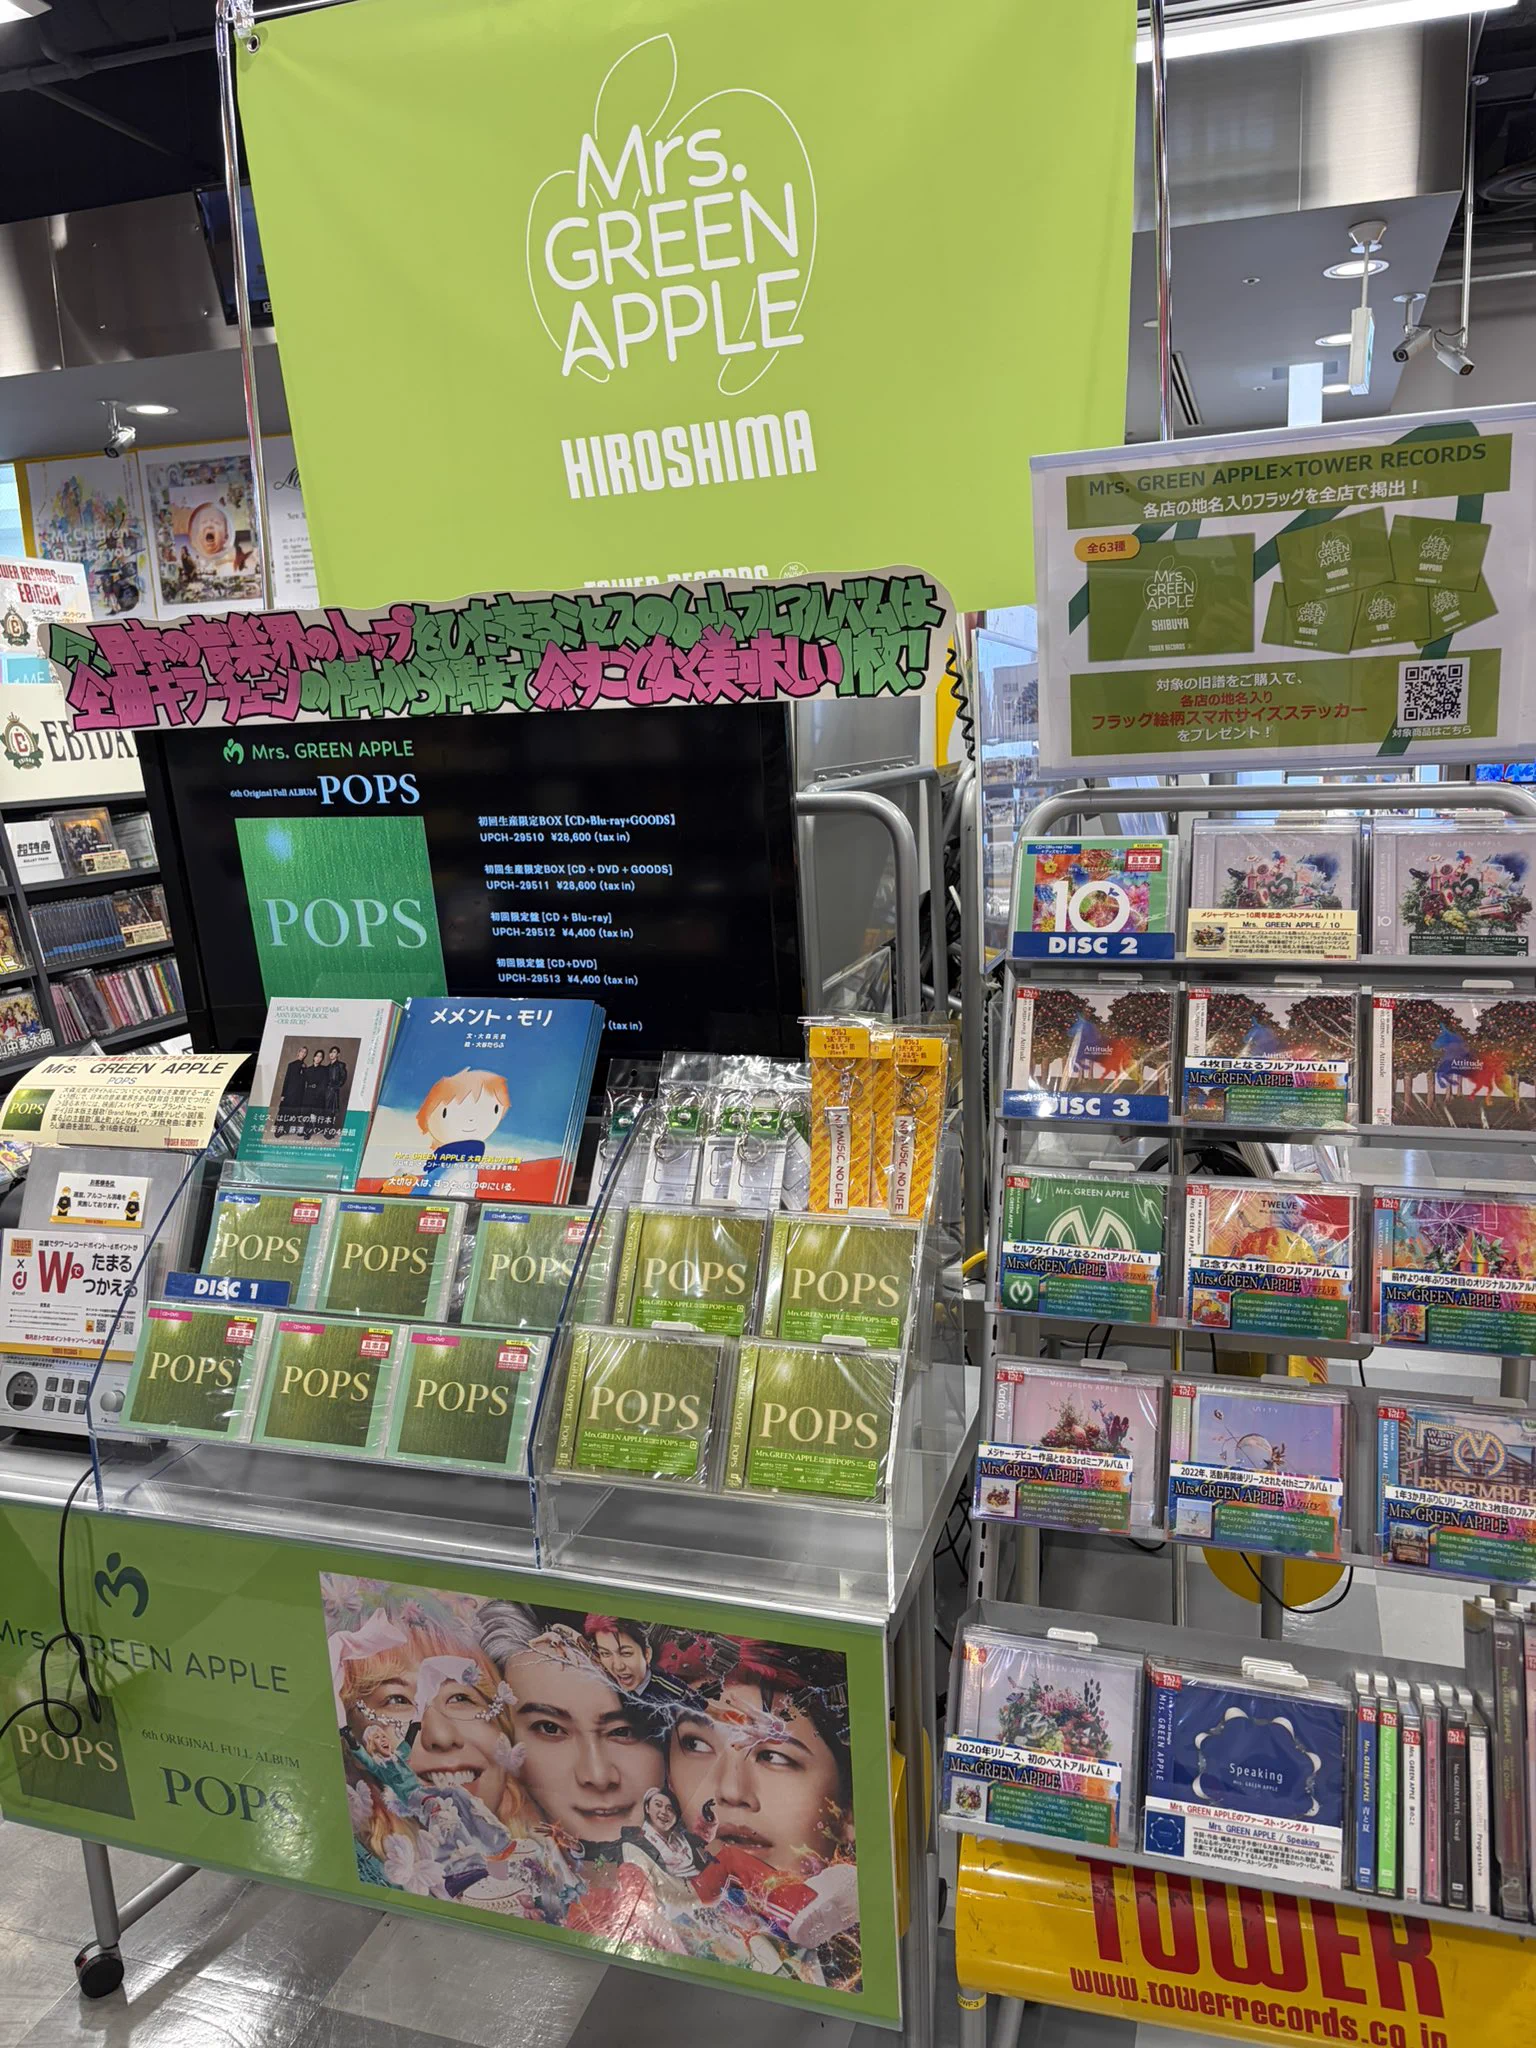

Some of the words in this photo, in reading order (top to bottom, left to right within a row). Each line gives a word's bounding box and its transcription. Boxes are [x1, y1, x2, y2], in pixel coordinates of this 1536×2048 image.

[577, 124, 748, 208] Mrs.
[545, 182, 798, 291] GREEN
[562, 268, 804, 377] APPLE
[561, 409, 817, 499] HIROSHIMA
[1089, 480, 1130, 497] Mrs.
[1138, 473, 1205, 493] GREEN
[1380, 443, 1487, 468] RECORDS
[1087, 540, 1127, 554] 全63種
[1147, 581, 1194, 597] GREEN
[1147, 594, 1194, 611] APPLE
[1152, 617, 1189, 631] SHIBUYA
[1156, 672, 1303, 692] 対象の旧譜をご購入で、
[1180, 690, 1273, 708] 各店の地名入り
[1091, 704, 1368, 732] フラッグ絵柄スマホサイズステッカー
[1177, 725, 1271, 743] をプレゼント！
[1392, 724, 1472, 738] 対象商品はこちら
[252, 744, 290, 760] Mrs.
[294, 742, 353, 759] GREEN
[359, 740, 414, 758] APPLE
[230, 788, 242, 798] 6th
[243, 789, 272, 799] Original
[274, 788, 287, 798] Full
[289, 788, 317, 798] ALBUM
[317, 773, 420, 805] POPS
[480, 833, 545, 843] UPCH-29510
[551, 833, 591, 843] ¥28,600
[594, 832, 615, 844] (tax
[616, 832, 631, 843] in)
[567, 864, 586, 876] [CD
[597, 865, 620, 875] DVD
[630, 864, 673, 876] GOODS]
[486, 881, 549, 891] UPCH-29511
[556, 881, 597, 891] ¥28,600
[599, 881, 620, 892] (tax
[621, 881, 636, 891] in)
[262, 897, 428, 949] POPS
[490, 911, 540, 923] 初回限定盤
[542, 912, 560, 924] [CD
[571, 912, 613, 924] Blu-ray]
[492, 928, 556, 938] UPCH-29512
[562, 928, 596, 939] ¥4,400
[598, 928, 619, 939] (tax
[620, 928, 634, 939] in)
[1048, 937, 1108, 954] DISC
[1119, 937, 1138, 955] 2
[496, 957, 545, 969] 初回限定盤
[547, 958, 598, 970] [CD+DVD]
[498, 974, 561, 984] UPCH-29513
[567, 974, 601, 984] ¥4,400
[603, 974, 624, 986] (tax
[624, 975, 639, 986] in)
[430, 1008, 553, 1027] メメント・モリ
[1084, 1045, 1114, 1053] Attitude
[1451, 1059, 1484, 1067] Attitude
[106, 1076, 137, 1086] POPS
[9, 1102, 45, 1115] POPS
[1112, 1099, 1131, 1117] 3
[836, 1166, 845, 1181] NO
[834, 1183, 844, 1205] LIFE
[1261, 1200, 1298, 1210] TWELVE
[218, 1232, 302, 1264] POPS
[1013, 1243, 1152, 1265] セルフタイトルとなる2ndアルバム！
[92, 1253, 132, 1273] たまる
[342, 1243, 428, 1275] POPS
[1005, 1256, 1028, 1271] Mrs.
[1028, 1259, 1067, 1275] GREEN
[1070, 1262, 1108, 1278] APPLE
[1200, 1259, 1348, 1279] 記念すべき1枚目のフルアルバム！
[38, 1250, 74, 1294] W
[488, 1253, 580, 1287] POPS
[642, 1257, 748, 1295] POPS
[83, 1278, 138, 1298] つかえる
[194, 1278, 241, 1299] DISC
[250, 1283, 259, 1299] 1
[790, 1268, 900, 1308] POPS
[1194, 1272, 1216, 1284] Mrs.
[1218, 1275, 1259, 1289] GREEN
[1262, 1277, 1300, 1292] APPLE
[1385, 1286, 1409, 1301] Mrs.
[1412, 1290, 1456, 1305] GREEN
[1459, 1292, 1500, 1309] APPLE
[147, 1351, 235, 1388] POPS
[280, 1366, 370, 1402] POPS
[414, 1379, 509, 1416] POPS
[587, 1386, 700, 1430] POPS
[996, 1382, 1009, 1420] Variety
[759, 1402, 878, 1449] POPS
[1004, 1464, 1043, 1479] GREEN
[1046, 1467, 1083, 1483] APPLE
[1175, 1482, 1197, 1495] Mrs.
[1200, 1485, 1241, 1501] GREEN
[1244, 1488, 1284, 1506] APPLE
[1388, 1503, 1413, 1519] Mrs.
[1415, 1507, 1461, 1526] GREEN
[1464, 1514, 1508, 1533] APPLE
[185, 1652, 290, 1694] APPLE
[16, 1724, 118, 1772] POPS
[141, 1728, 158, 1741] 6th
[160, 1731, 219, 1753] ORIGINAL
[220, 1744, 253, 1760] FULL
[254, 1751, 300, 1769] ALBUM
[956, 1742, 1111, 1777] 2020年リリース、初のベストアルバム！
[951, 1757, 974, 1773] Mrs.
[975, 1761, 1014, 1782] GREEN
[1019, 1769, 1060, 1790] APPLE
[1229, 1763, 1284, 1784] Speaking
[159, 1766, 299, 1830] POPS
[1170, 1803, 1184, 1813] Mrs.
[1187, 1806, 1212, 1817] GREEN
[1075, 1855, 1446, 2019] TOWER
